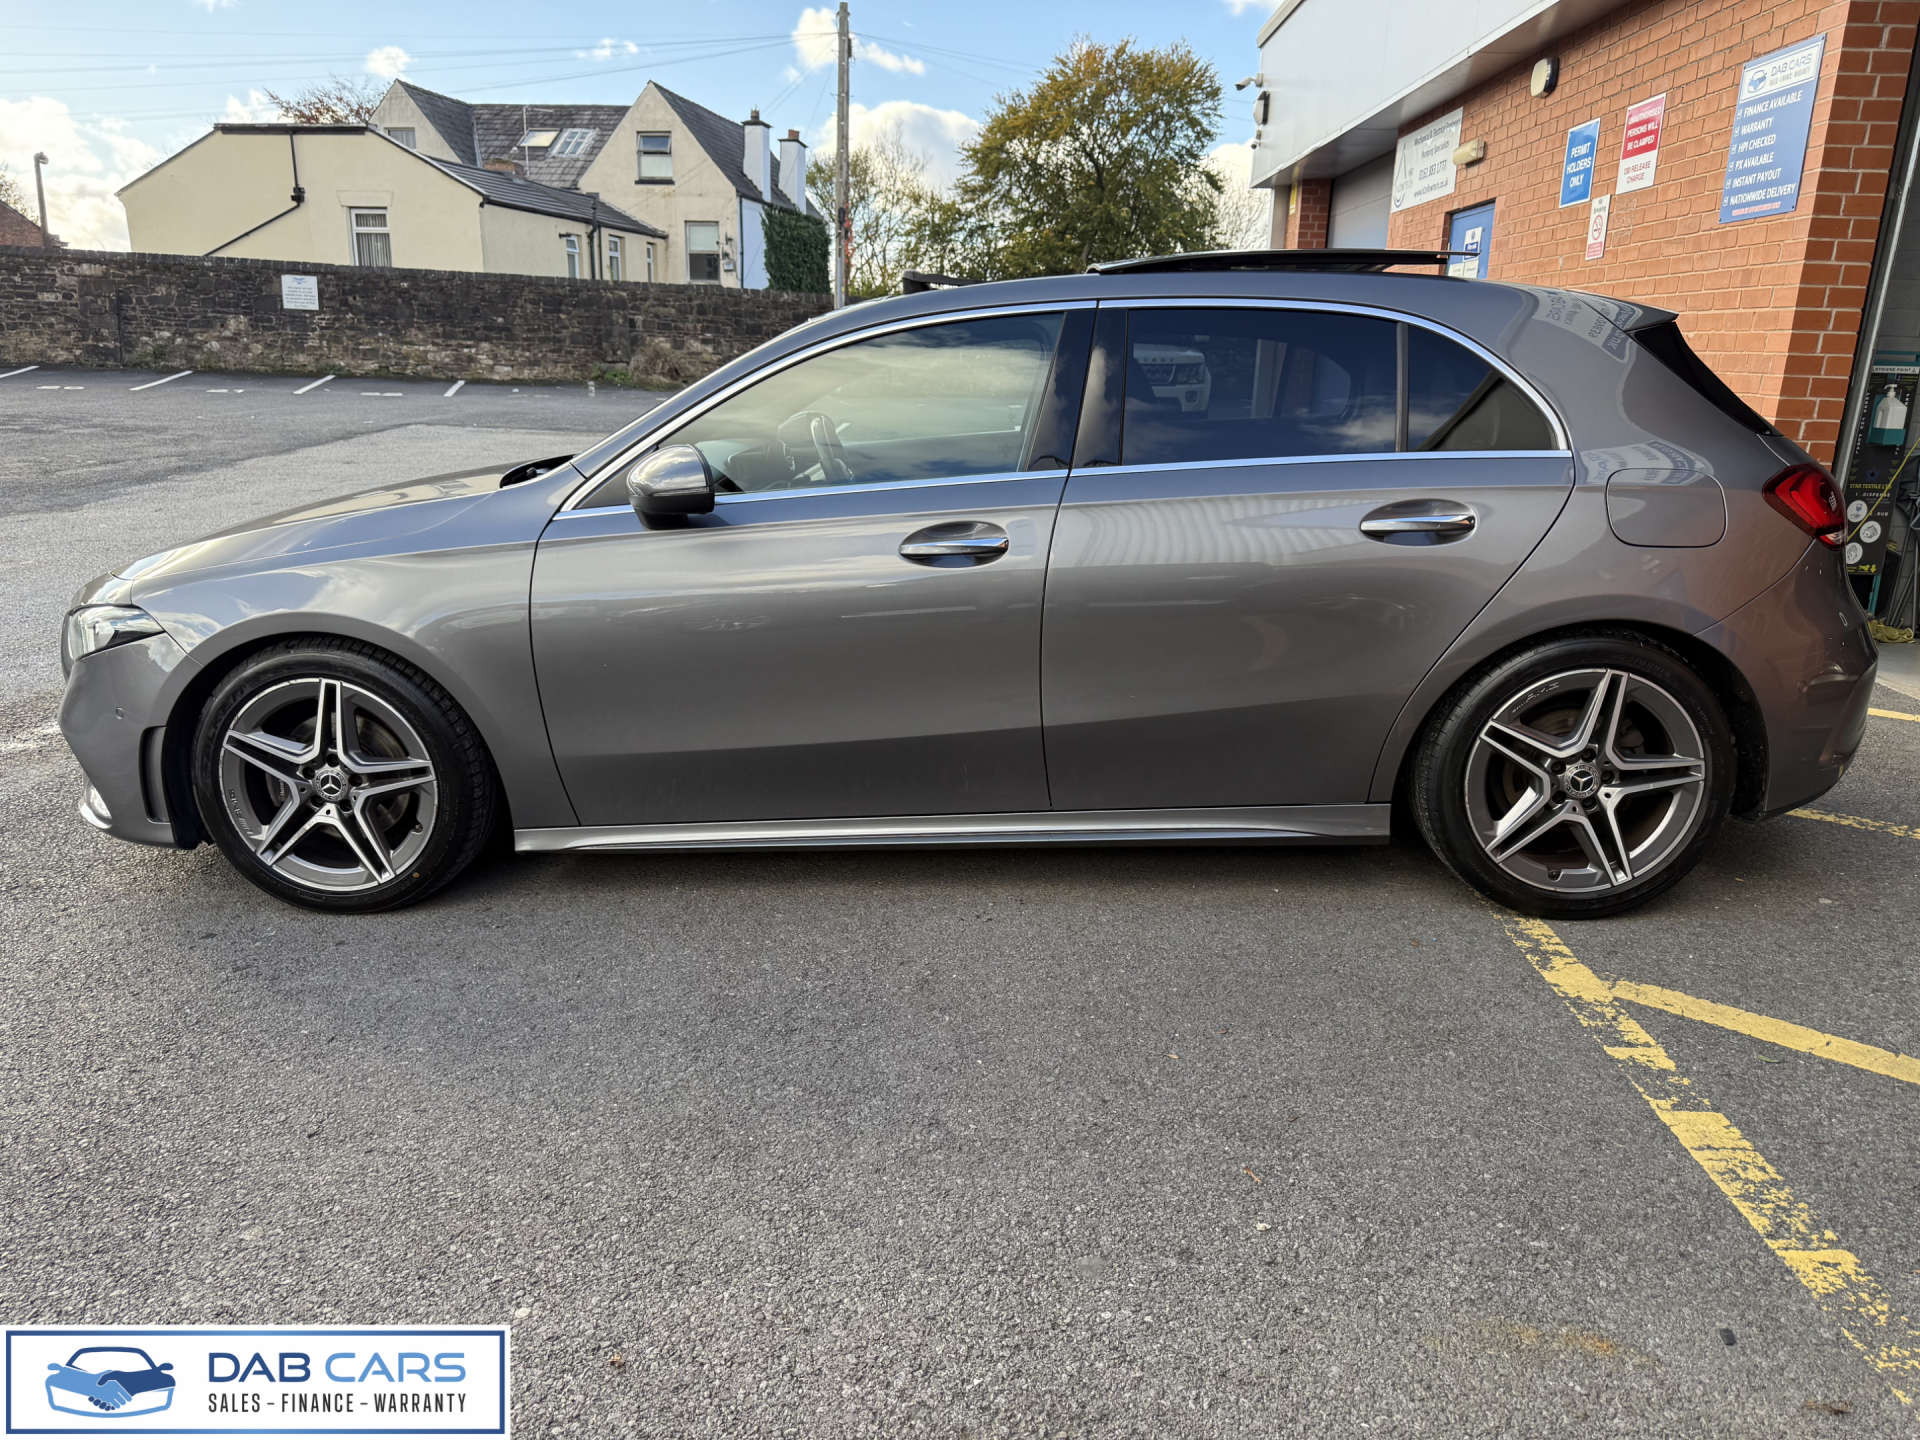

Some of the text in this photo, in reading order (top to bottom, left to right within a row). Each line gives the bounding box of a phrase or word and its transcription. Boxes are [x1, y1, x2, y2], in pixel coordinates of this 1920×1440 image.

[1771, 62, 1787, 76] DAB
[1743, 90, 1803, 118] FINANCE AVAILABLE
[1741, 117, 1774, 135] WARRANTY
[1570, 142, 1591, 158] PERMIT
[1633, 134, 1655, 148] CLAMPED
[1738, 134, 1776, 153] HPI CHECKED
[1567, 157, 1591, 175] HOLDERS
[1735, 152, 1774, 170] PX AVAILABLE
[1569, 174, 1584, 188] ONLY
[1732, 167, 1782, 188] INSTANT PAYOUT
[1730, 183, 1797, 206] NATIONWIDE DELIVERY
